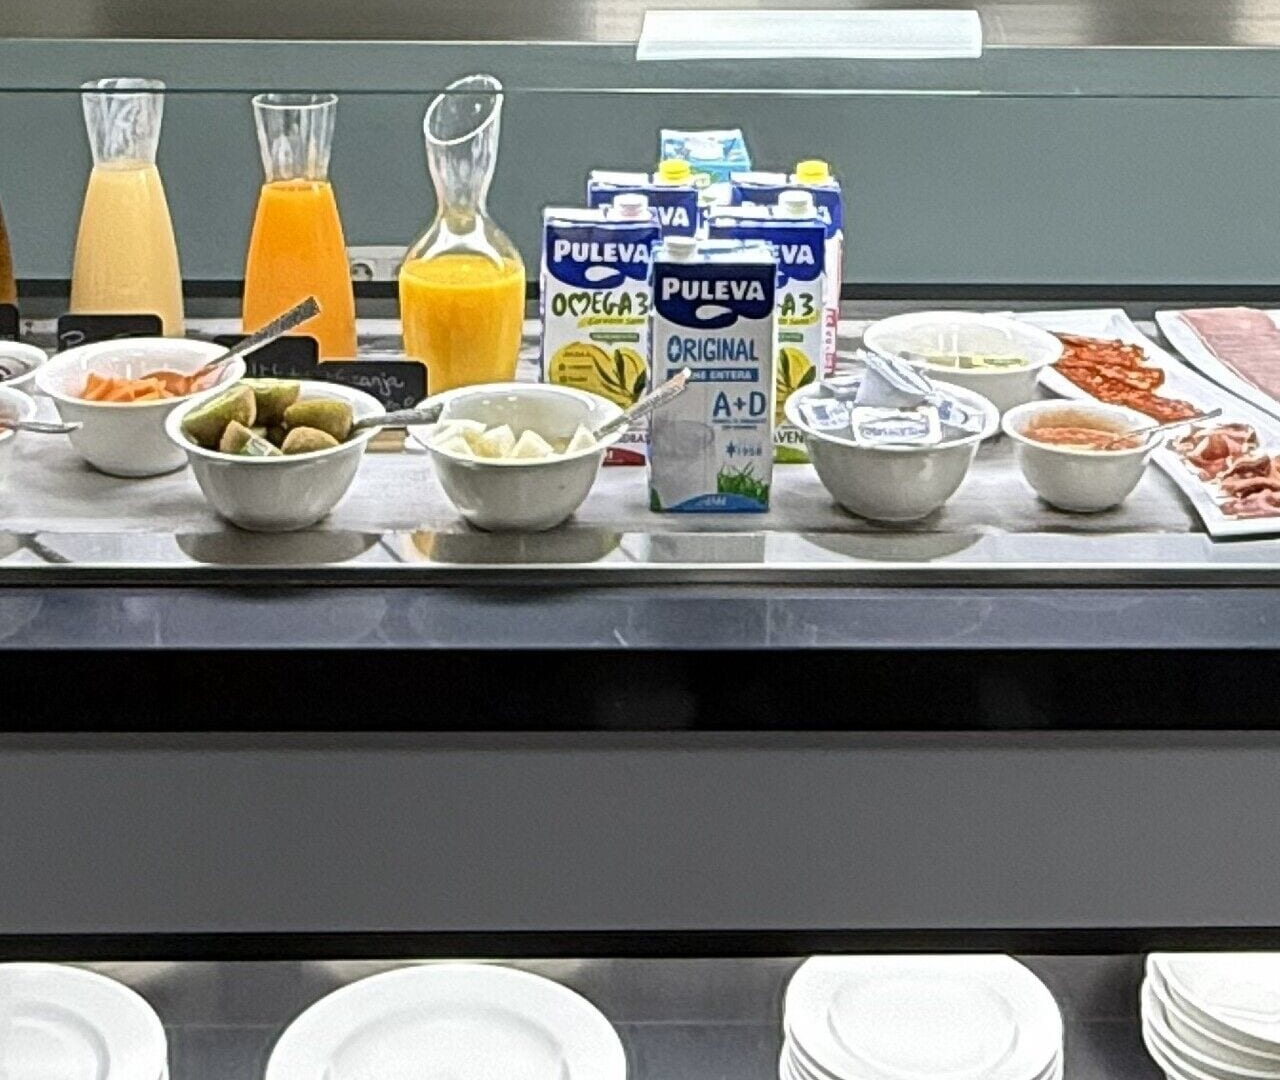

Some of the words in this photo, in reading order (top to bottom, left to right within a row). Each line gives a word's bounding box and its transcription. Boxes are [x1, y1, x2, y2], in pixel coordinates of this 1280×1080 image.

[553, 239, 648, 263] PULEVA
[662, 277, 766, 301] PULEVA
[635, 291, 648, 316] 3
[667, 335, 759, 363] ORIGINAL
[713, 391, 767, 416] A+D
